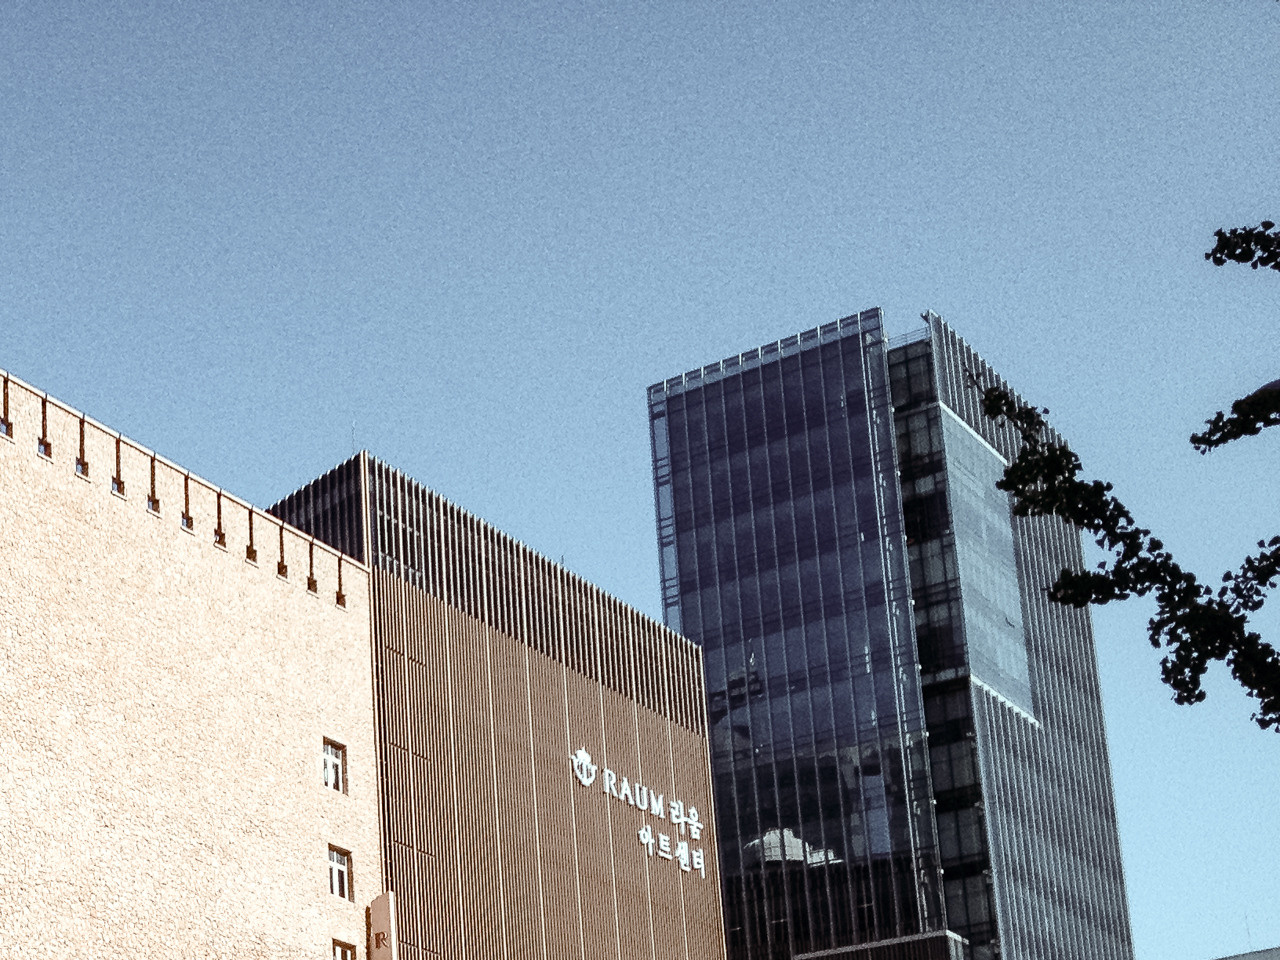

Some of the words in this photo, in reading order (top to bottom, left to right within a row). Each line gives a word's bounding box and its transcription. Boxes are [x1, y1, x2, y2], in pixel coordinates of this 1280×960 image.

[603, 768, 665, 819] RAUM
[669, 800, 704, 840] 라움
[638, 825, 705, 879] 아트센터
